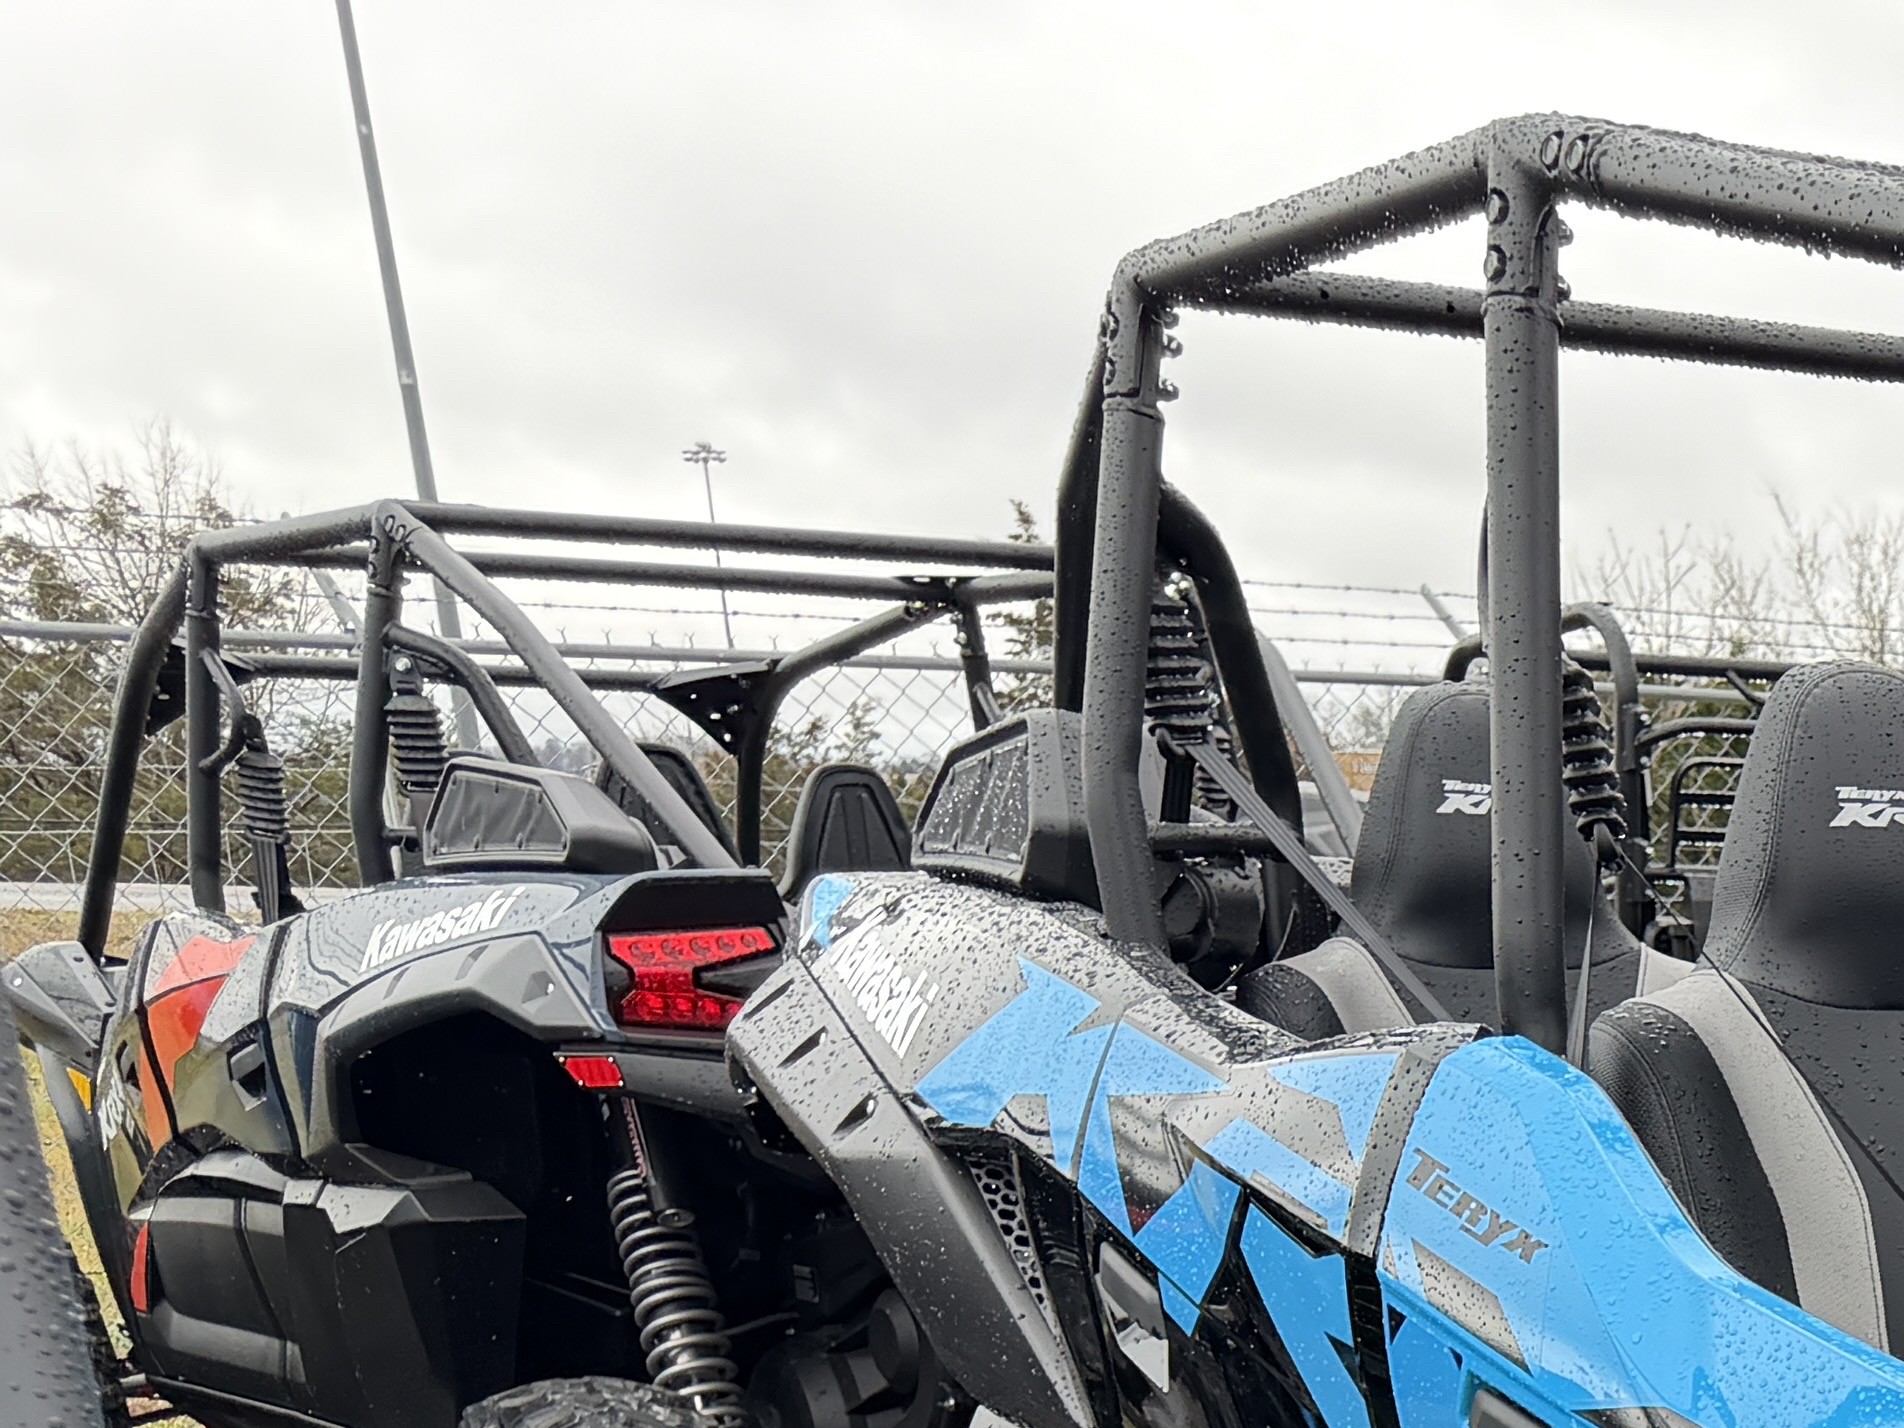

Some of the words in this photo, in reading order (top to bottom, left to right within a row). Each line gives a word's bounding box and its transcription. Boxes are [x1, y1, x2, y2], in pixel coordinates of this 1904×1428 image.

[358, 886, 526, 973] Kawasaki
[829, 906, 940, 1059] Kawasaki
[1406, 1147, 1549, 1264] TERYX
